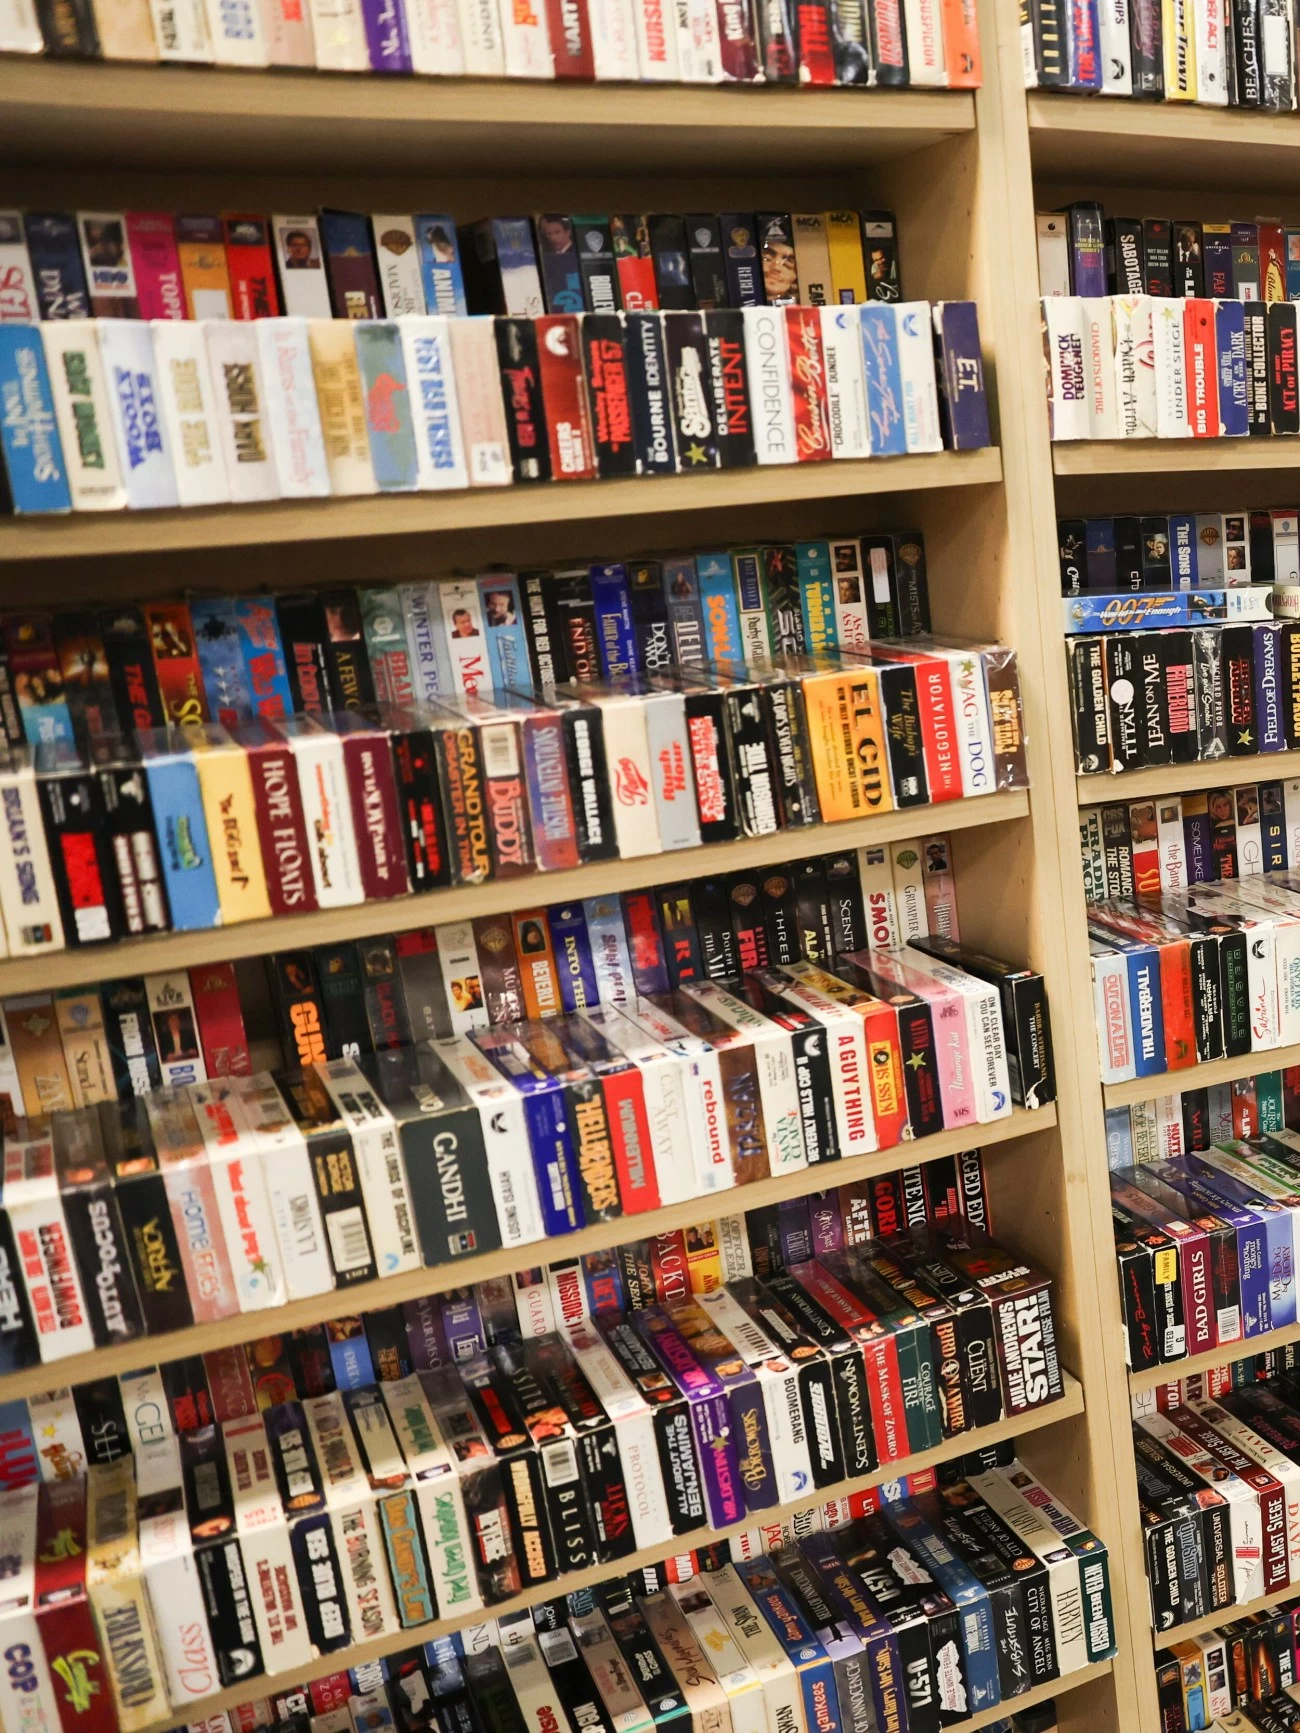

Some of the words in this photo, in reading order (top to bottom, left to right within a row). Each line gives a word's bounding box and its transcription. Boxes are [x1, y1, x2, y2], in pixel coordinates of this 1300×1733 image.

[1178, 37, 1188, 91] Town
[1243, 17, 1257, 99] BEACHES
[641, 321, 660, 386] IDENTITY
[796, 319, 821, 388] Bette
[1172, 322, 1181, 364] SIEGE
[1252, 316, 1266, 377] COLLECTOR
[756, 317, 785, 453] CONFIDENCE
[957, 358, 978, 392] E.T.
[1173, 368, 1183, 419] UNDER
[1194, 344, 1205, 406] TROUBLE
[1255, 379, 1267, 410] BONE
[649, 390, 668, 463] BOURNE
[798, 390, 824, 454] Cousin
[1196, 409, 1207, 433] BIG
[526, 579, 536, 593] THE
[528, 595, 545, 616] HUNT
[1103, 597, 1175, 626] 007
[534, 618, 547, 634] FOR
[535, 637, 550, 652] RED
[1143, 654, 1160, 683] ME
[1262, 633, 1276, 691] DREAMS
[852, 683, 871, 731] EL
[1146, 686, 1155, 706] ON
[1166, 666, 1189, 733] FATHERLAND
[1267, 692, 1276, 705] OF
[1148, 707, 1164, 747] LEAN
[1265, 706, 1278, 744] FIELD
[262, 760, 292, 821] HOPE
[457, 729, 482, 818] GRAND
[660, 747, 675, 801] Rush
[673, 741, 686, 792] Hour
[858, 737, 882, 807] CID
[488, 778, 522, 866] BUDDY
[273, 827, 306, 906] FLOATS
[469, 821, 489, 876] TOUR
[1137, 966, 1155, 1060] THUNDERBALL
[980, 999, 988, 1013] YOU
[987, 1051, 998, 1088] FOREVER
[797, 1067, 812, 1091] COP
[703, 1080, 726, 1164] rebound
[798, 1092, 816, 1122] HILLS
[802, 1124, 821, 1165] BEVERLY
[433, 1132, 467, 1222] GANDHI
[1191, 1250, 1204, 1308] GIRLS
[999, 1301, 1022, 1370] ANDREWS
[1015, 1295, 1049, 1403] STAR!
[1197, 1310, 1209, 1342] BAD
[784, 1377, 804, 1444] BOOMERANG
[843, 1359, 860, 1413] WOMAN
[902, 1377, 920, 1409] FIRE
[920, 1362, 936, 1413] COURAGE
[1009, 1371, 1027, 1408] JULIE
[674, 1414, 703, 1517] BENJAMINS
[855, 1425, 869, 1470] SCENT
[559, 1490, 587, 1564] BLISS
[1164, 1528, 1173, 1544] THE
[1211, 1512, 1224, 1563] UNIVERSAL
[1267, 1496, 1283, 1530] SIEGE
[1167, 1546, 1176, 1576] GOLDEN
[1267, 1533, 1280, 1562] LAST
[1084, 1562, 1104, 1595] NEVER
[1170, 1578, 1179, 1607] CHILD
[1216, 1564, 1229, 1605] SOLDIER
[1270, 1565, 1281, 1585] THE
[1056, 1587, 1084, 1646] HARVEY
[1090, 1593, 1104, 1619] BEEN
[177, 1623, 214, 1694] Class
[1089, 1616, 1110, 1652] KISSED
[847, 1662, 867, 1720] INNOCENCE
[906, 1657, 933, 1709] U-571
